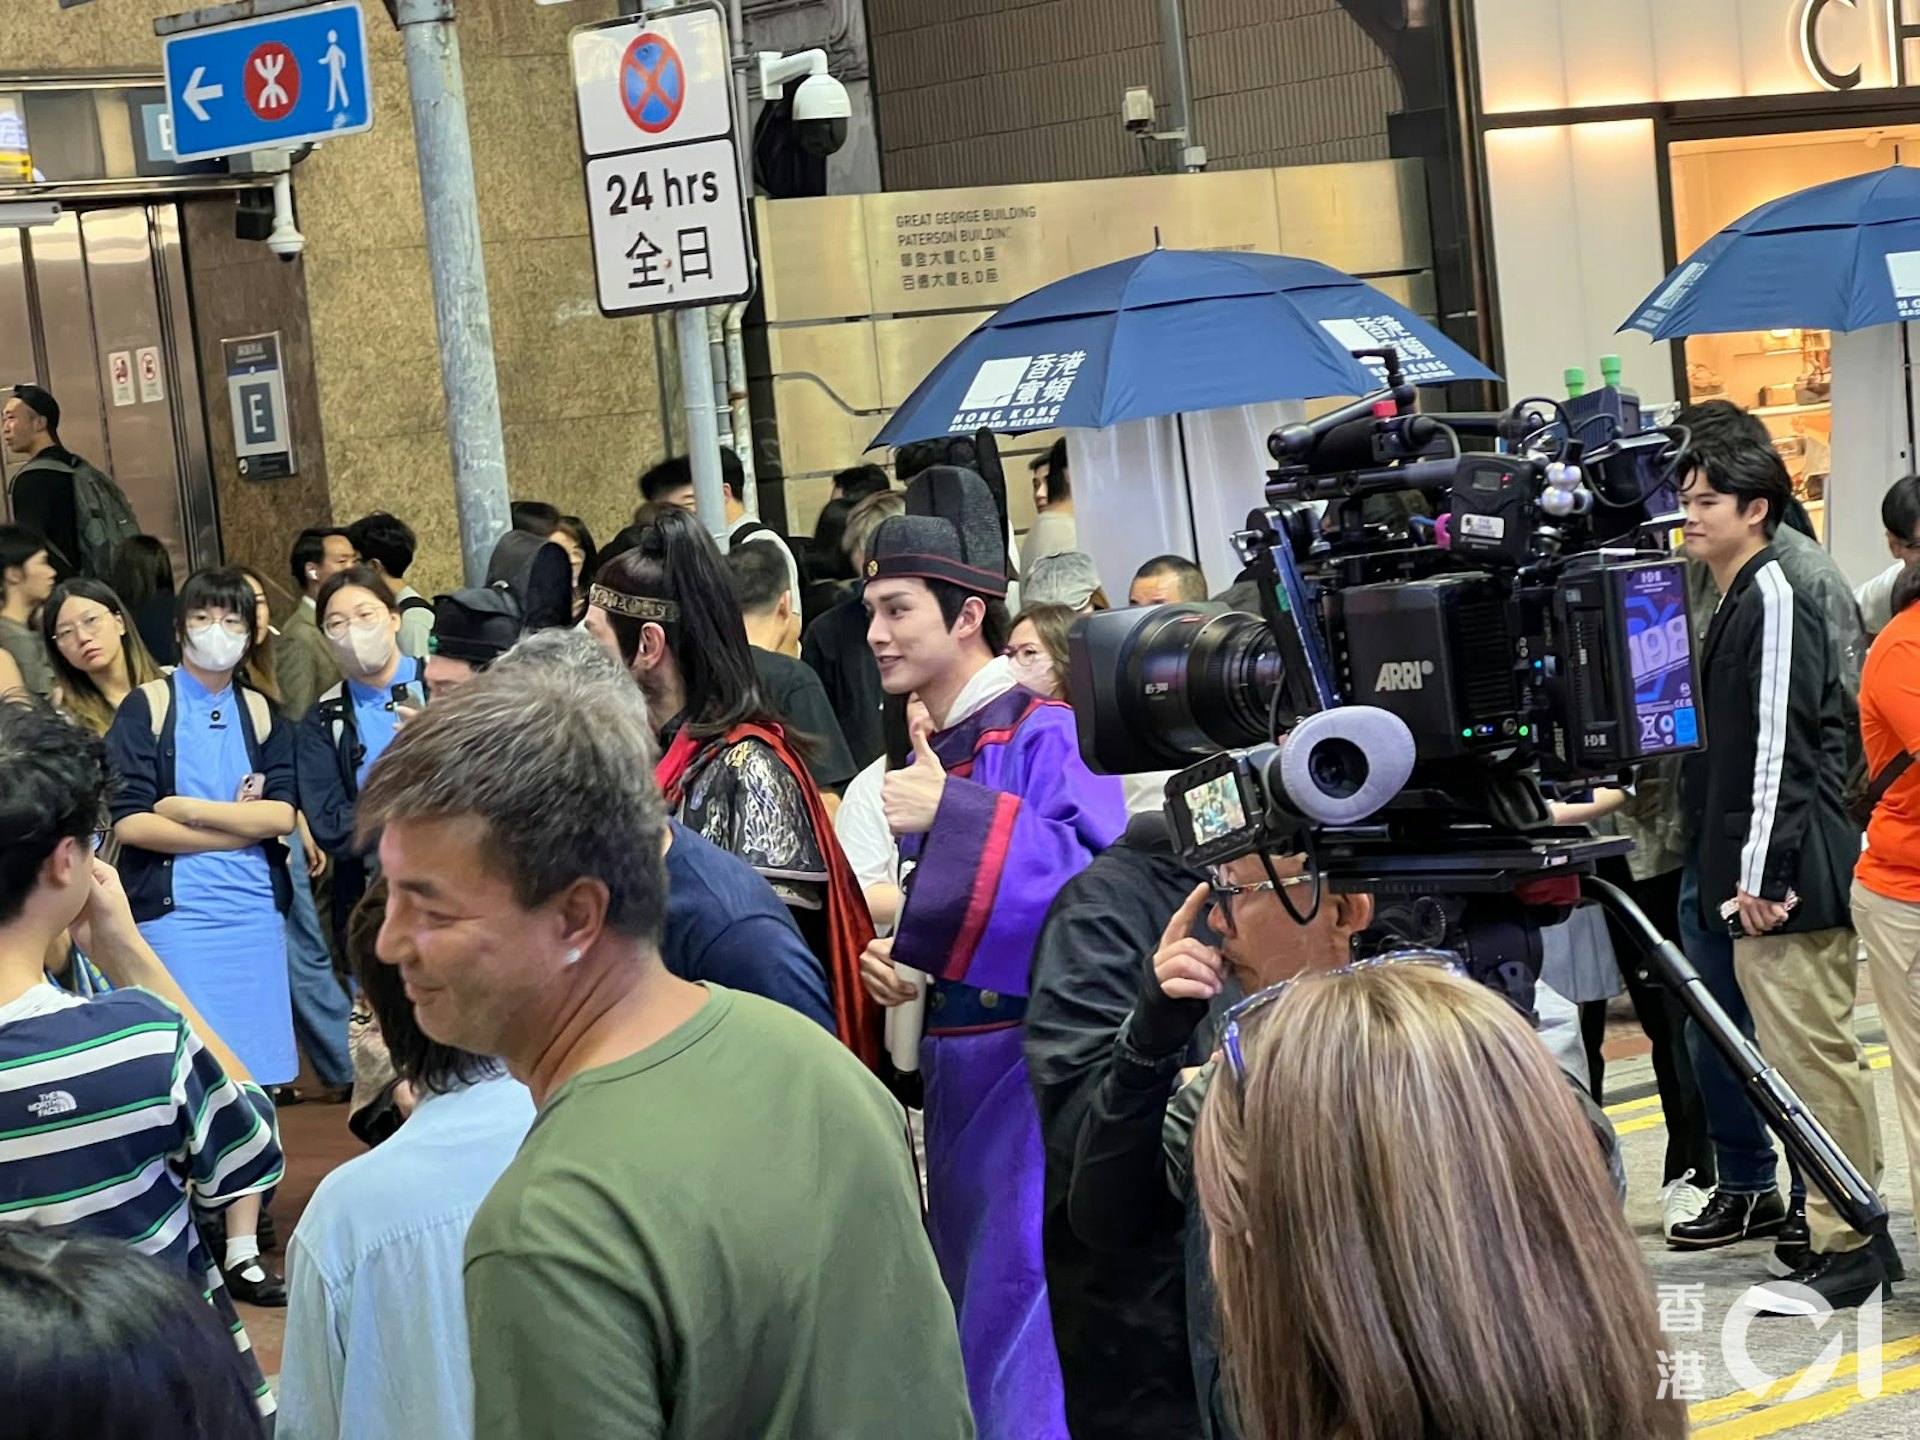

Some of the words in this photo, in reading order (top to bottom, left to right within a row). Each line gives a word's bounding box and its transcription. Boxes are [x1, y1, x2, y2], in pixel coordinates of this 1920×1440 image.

[607, 171, 654, 216] 24
[663, 168, 719, 207] hrs
[896, 213, 931, 228] GREAT
[935, 209, 980, 225] GEORGE
[983, 206, 1037, 222] BUILDING
[898, 230, 957, 247] PATERSON
[960, 226, 1013, 242] BUILDING
[625, 226, 713, 289] 全日
[1026, 350, 1087, 380] 香港
[1010, 376, 1076, 406] 寬頻
[249, 393, 266, 434] E
[948, 420, 1008, 432] BROADAND
[952, 409, 1003, 424] HONG
[1009, 405, 1061, 420] KONG
[1375, 660, 1423, 692] ARRI
